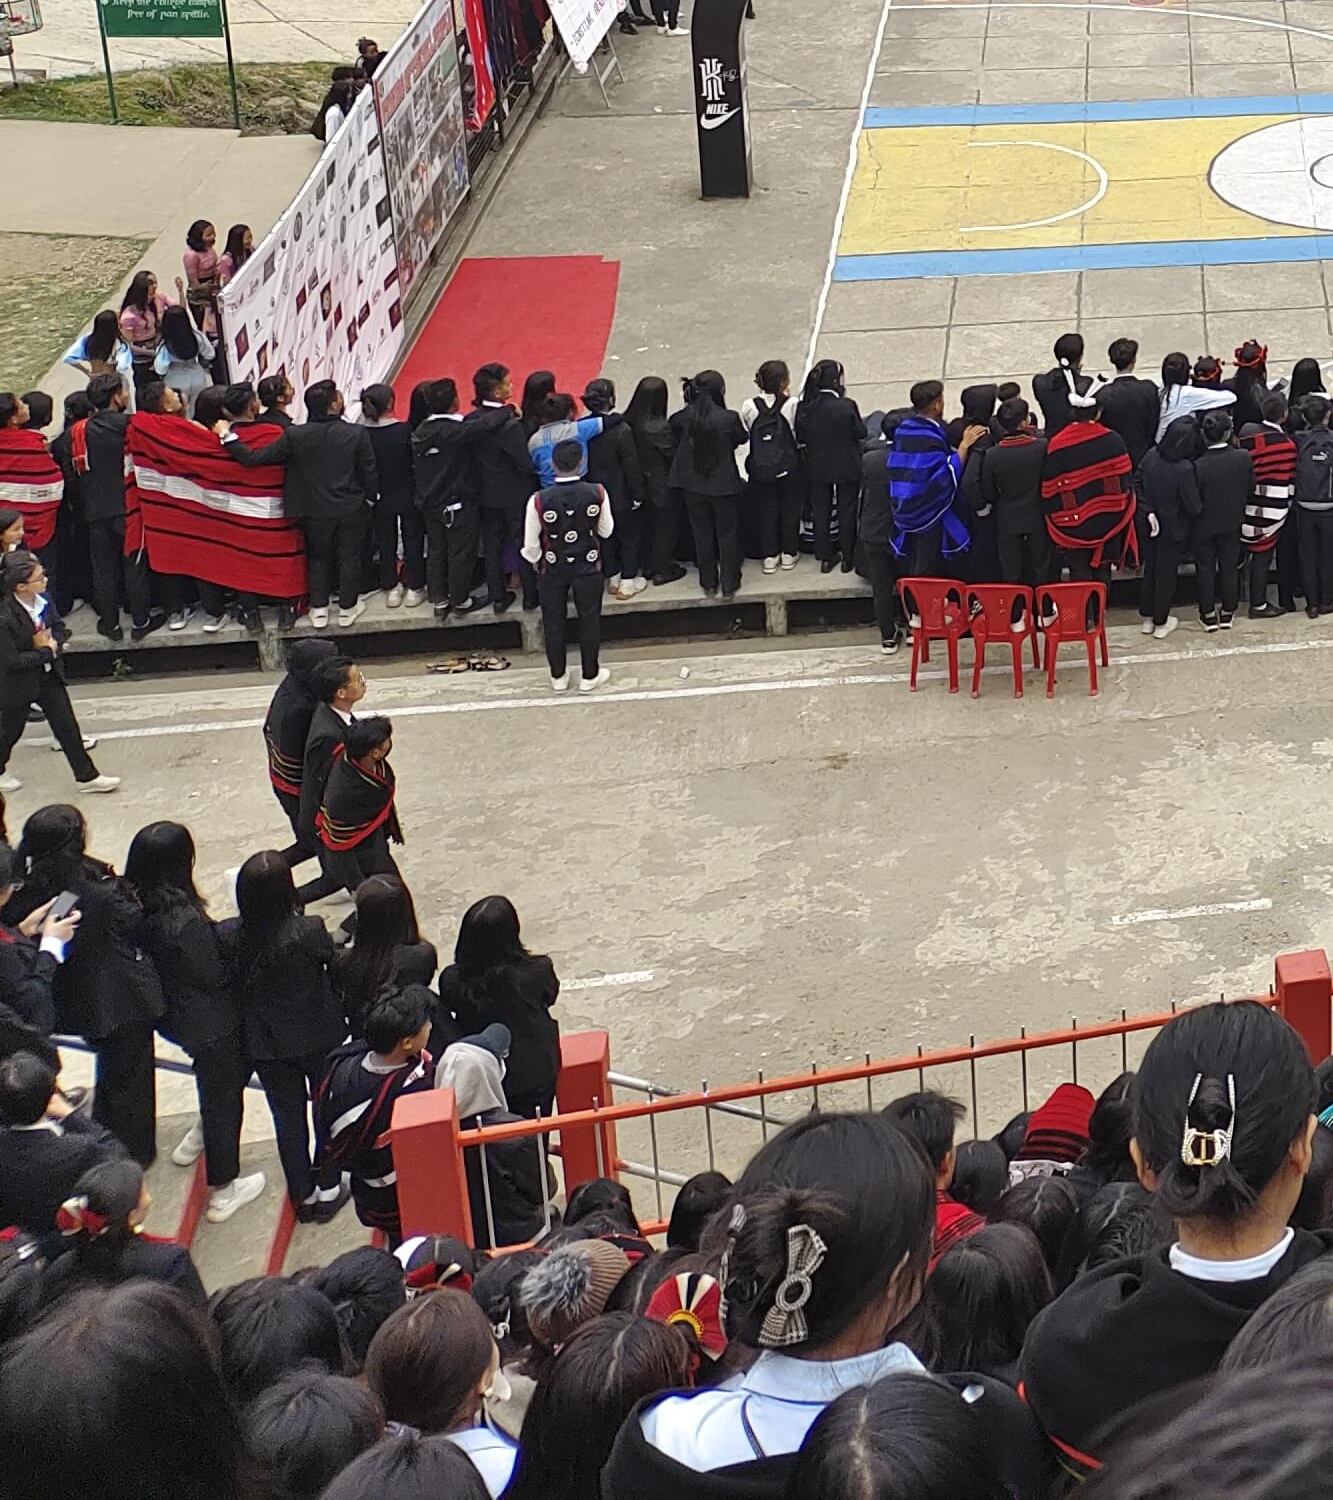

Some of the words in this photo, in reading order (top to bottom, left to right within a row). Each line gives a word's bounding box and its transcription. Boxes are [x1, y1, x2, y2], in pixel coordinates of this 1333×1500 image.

[128, 10, 144, 19] free
[146, 10, 157, 19] of
[160, 11, 178, 20] pan
[706, 103, 729, 115] NIKE
